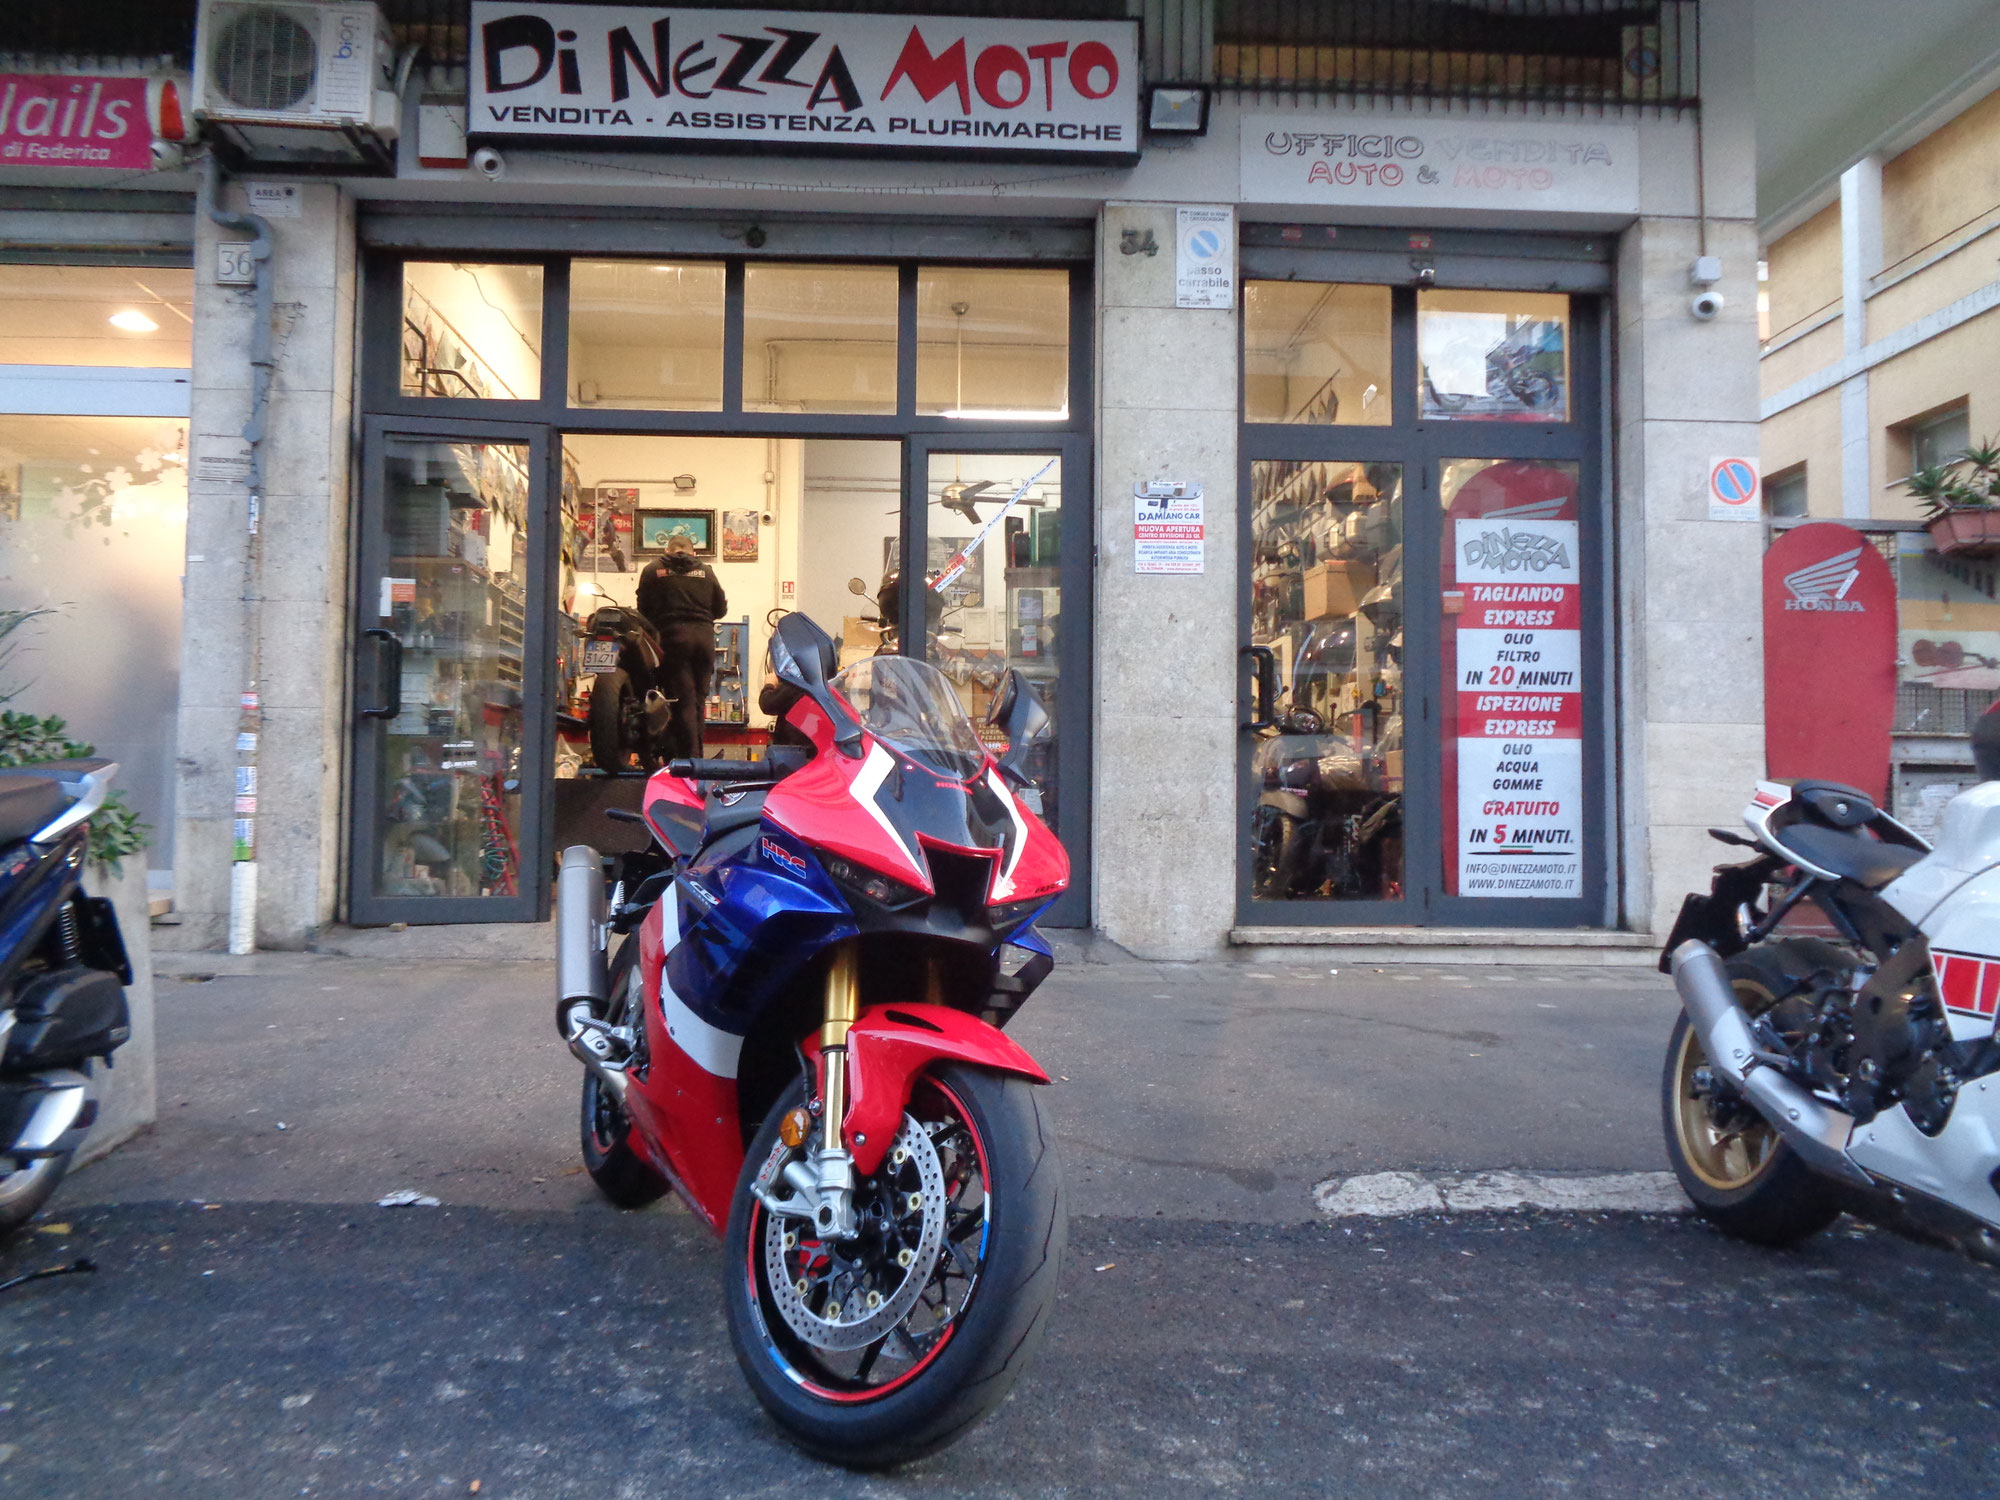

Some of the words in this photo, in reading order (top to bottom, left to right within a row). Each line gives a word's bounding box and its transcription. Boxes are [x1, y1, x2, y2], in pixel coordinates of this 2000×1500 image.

[482, 15, 582, 95] Di
[880, 24, 1120, 116] MOTO
[488, 105, 634, 126] VENDITA
[665, 110, 877, 134] ASSISTENZA
[887, 117, 1123, 142] PLURIMARCHE
[3, 141, 24, 157] di
[26, 142, 112, 160] Federica
[1264, 131, 1425, 160] UFFICIO
[1434, 136, 1613, 167] VENDITA
[1308, 161, 1404, 188] AUTO
[1416, 165, 1440, 185] &
[1453, 165, 1555, 191] MOTO
[220, 250, 252, 276] 36
[1138, 511, 1183, 521] DAMIANO
[1185, 512, 1200, 520] CAR
[1138, 525, 1164, 533] NUOVA
[1480, 549, 1549, 574] MOTO
[1472, 586, 1565, 603] TAGLIANDO
[1784, 599, 1866, 612] HONDA
[1484, 609, 1555, 626] EXPRESS
[1503, 633, 1534, 645] OLIO
[1496, 650, 1541, 663] FILTRO
[1466, 670, 1483, 685] IN
[1488, 665, 1515, 685] 20
[1518, 671, 1574, 686] MINUTI
[1476, 695, 1563, 712] ISPEZIONE
[1484, 719, 1557, 736] EXPRESS
[1502, 743, 1533, 755] OLIO
[1496, 761, 1539, 774] ACQUA
[1492, 778, 1543, 790] GOMME
[1482, 801, 1560, 816] GRATUITO
[1469, 829, 1488, 843] IN
[1493, 824, 1507, 844] 5
[762, 836, 806, 880] HRC
[1465, 863, 1577, 875] INFO@DINEZZAMOTO.IT
[1467, 879, 1574, 890] WWW.DINEZZAMOTO.IT
[760, 1142, 785, 1181] brembo
